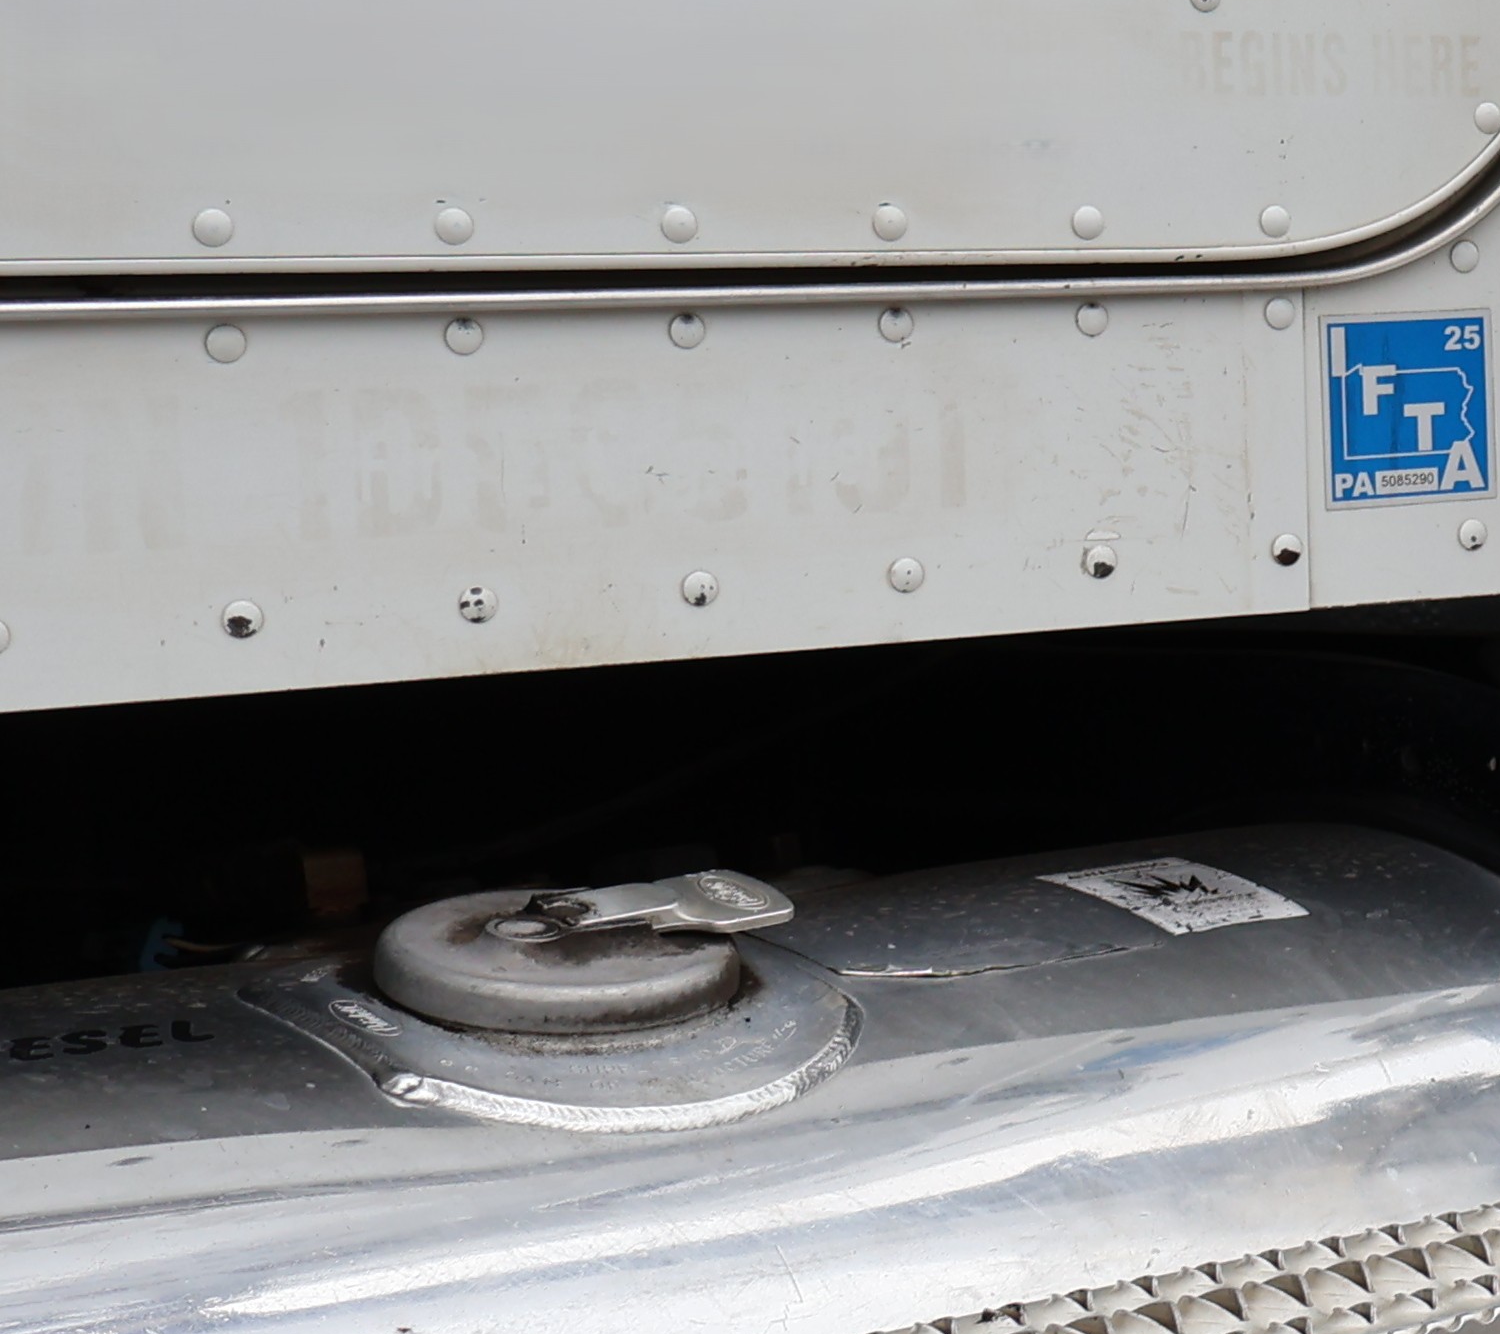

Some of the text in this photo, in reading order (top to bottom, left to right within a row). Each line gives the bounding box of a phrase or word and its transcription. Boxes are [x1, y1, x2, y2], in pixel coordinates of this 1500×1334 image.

[1444, 325, 1481, 351] 25
[1334, 471, 1435, 498] PA 5085290
